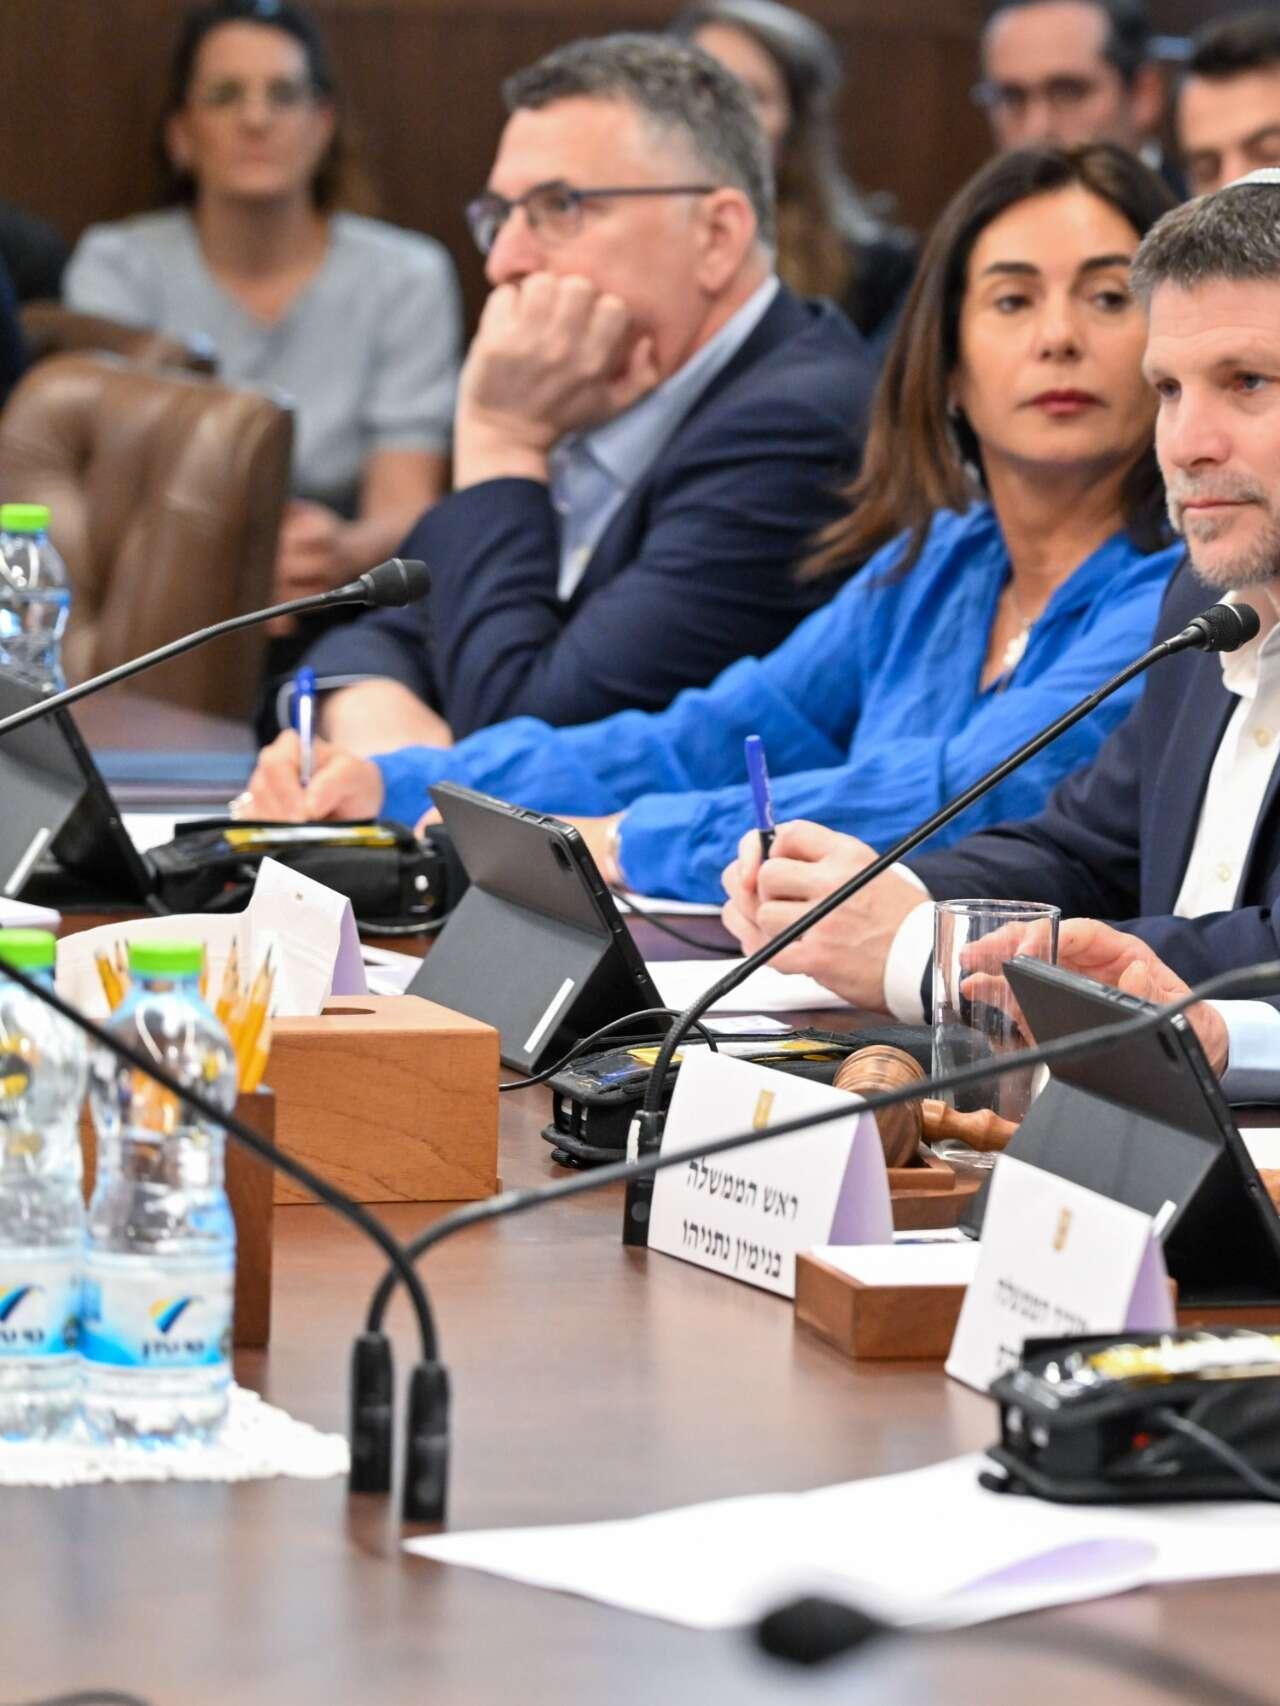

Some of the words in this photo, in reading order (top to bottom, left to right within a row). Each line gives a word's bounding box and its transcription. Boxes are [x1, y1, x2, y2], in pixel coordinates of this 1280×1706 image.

[686, 1156, 758, 1207] הממשלה
[763, 1184, 799, 1221] ראש
[682, 1218, 731, 1260] נתניהו
[735, 1237, 782, 1278] בנימין
